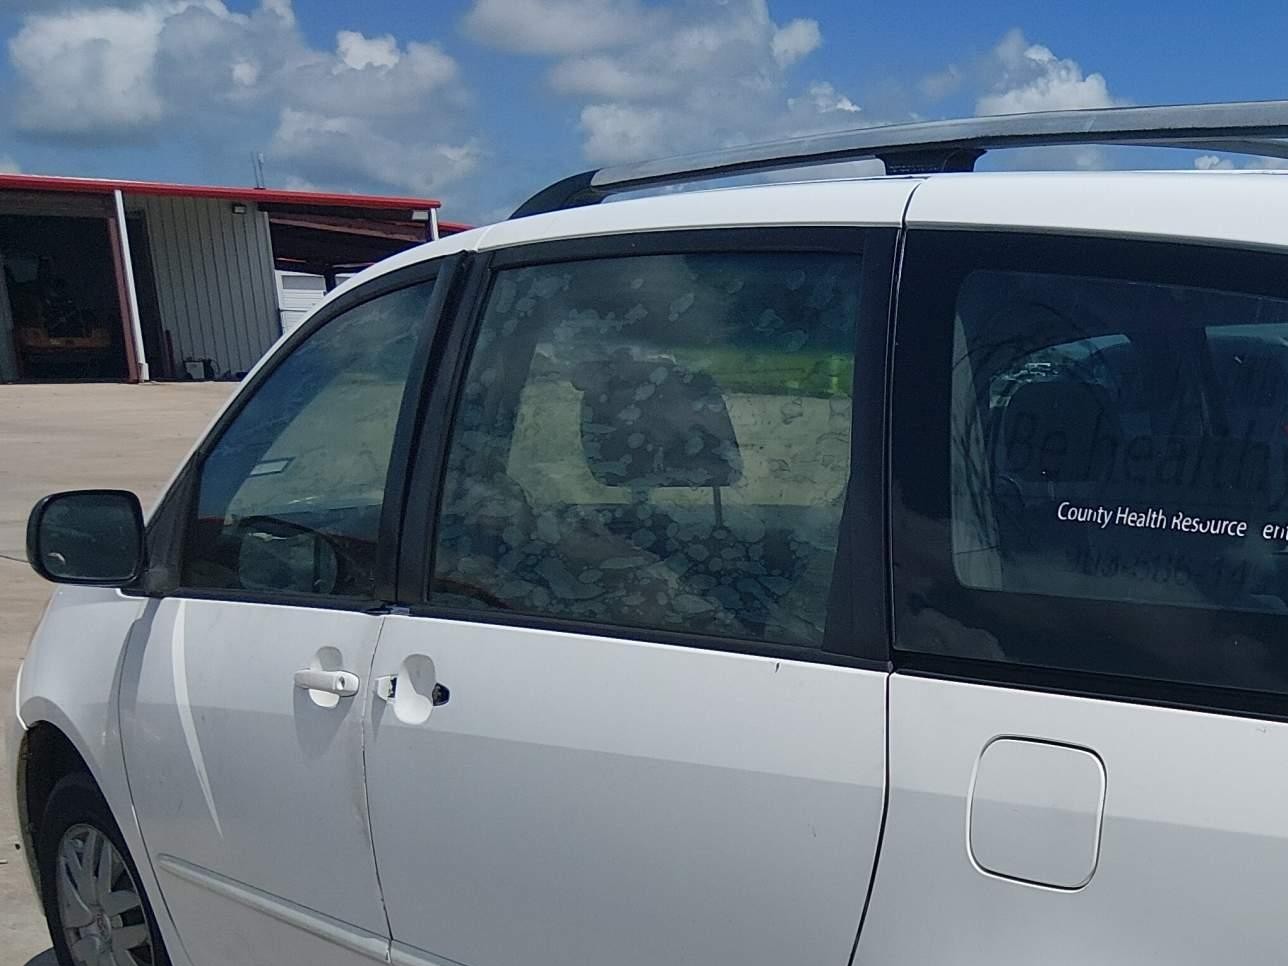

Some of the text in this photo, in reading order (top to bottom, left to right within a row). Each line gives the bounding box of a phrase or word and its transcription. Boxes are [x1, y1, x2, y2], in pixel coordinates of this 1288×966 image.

[1057, 501, 1113, 529] County
[1115, 506, 1167, 530] Health
[1171, 511, 1248, 537] Resource
